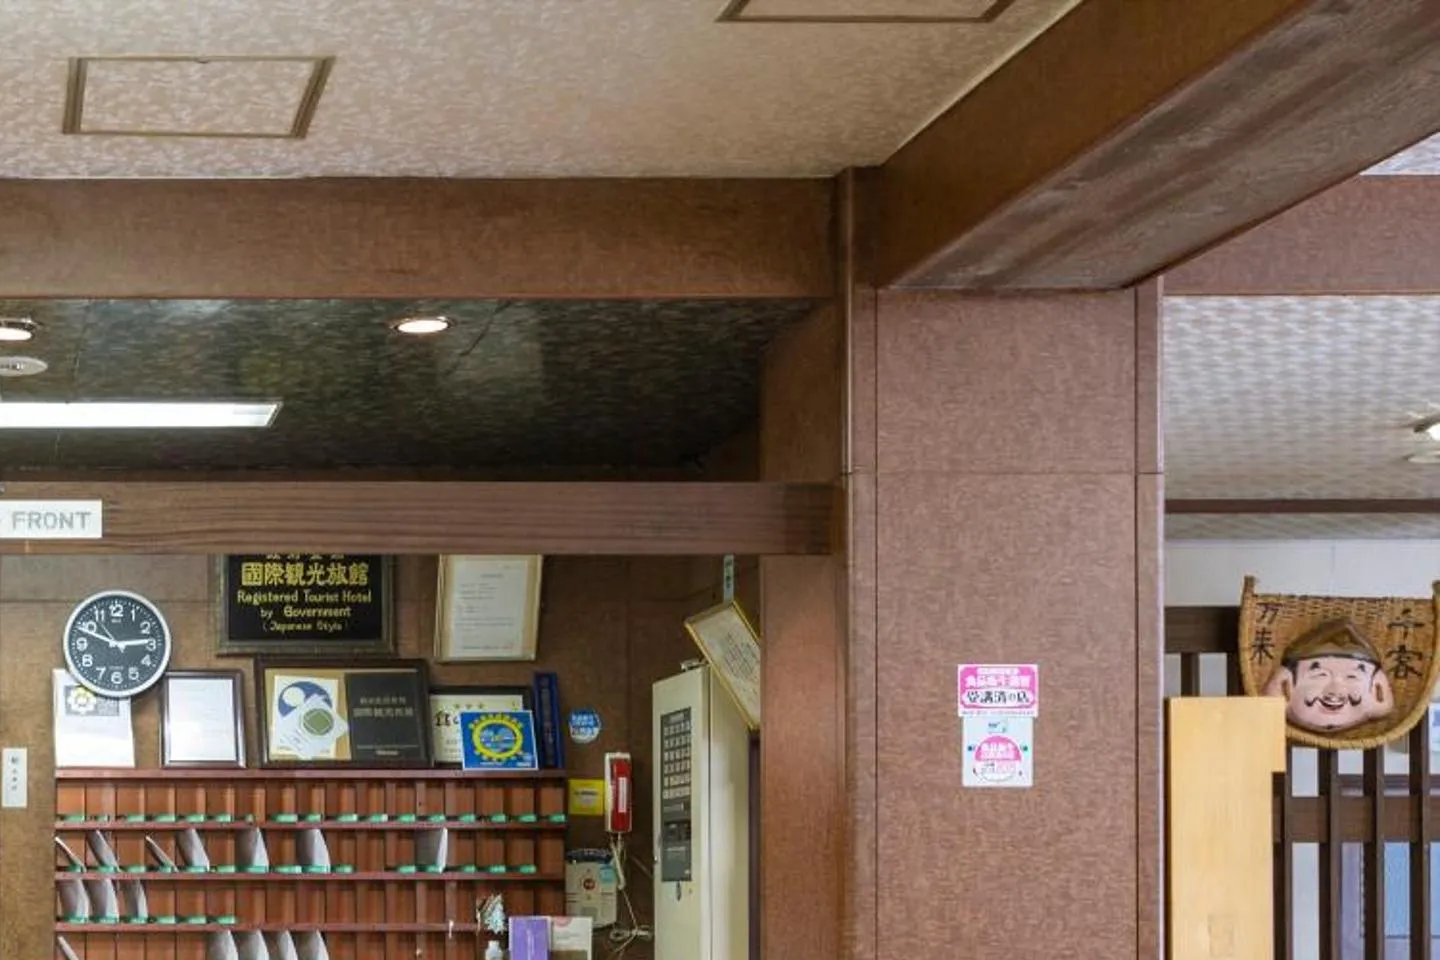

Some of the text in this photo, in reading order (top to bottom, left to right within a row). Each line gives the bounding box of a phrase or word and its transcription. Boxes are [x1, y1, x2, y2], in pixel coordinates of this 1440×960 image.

[12, 511, 91, 530] FRONT
[237, 589, 372, 605] Registered Tourist Hotel
[94, 608, 105, 621] 11
[109, 604, 123, 617] 12
[261, 605, 352, 620] by Government
[140, 621, 150, 634] 2
[76, 637, 87, 651] 9
[146, 638, 156, 651] 3
[82, 654, 93, 667] 8
[141, 654, 151, 666] 4
[95, 666, 106, 680] 7
[111, 671, 123, 684] 6
[128, 667, 139, 680] 5
